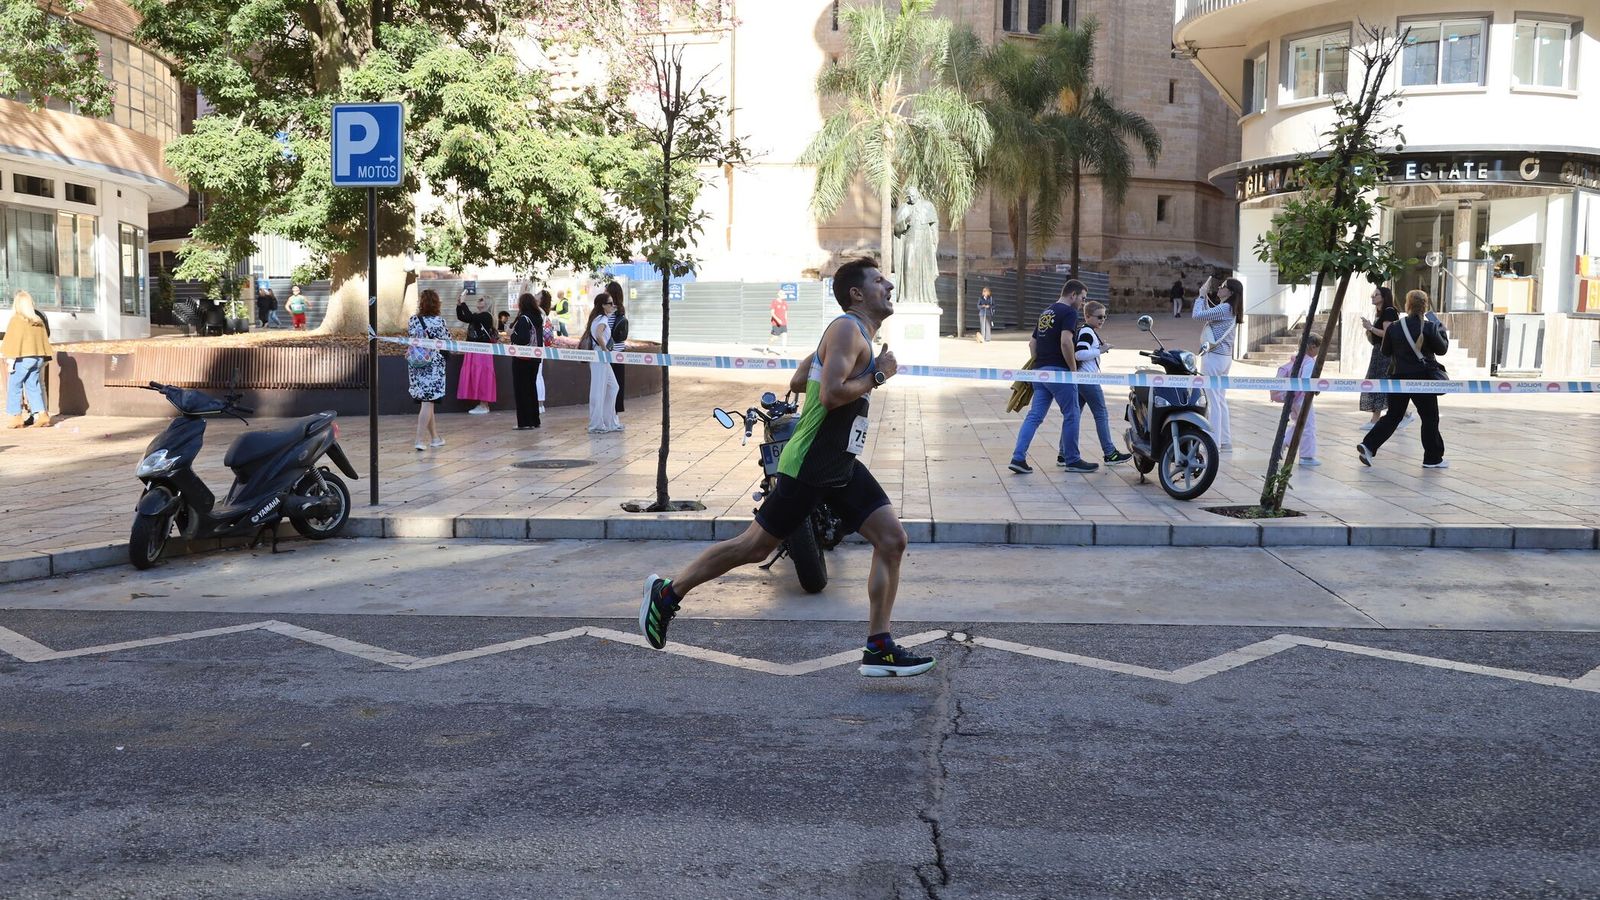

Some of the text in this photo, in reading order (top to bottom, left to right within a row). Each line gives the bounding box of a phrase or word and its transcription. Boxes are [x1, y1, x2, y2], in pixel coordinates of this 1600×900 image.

[337, 112, 380, 176] P
[358, 165, 397, 178] MOTOS
[1405, 162, 1489, 180] ESTATE
[258, 497, 280, 517] YAMAHA
